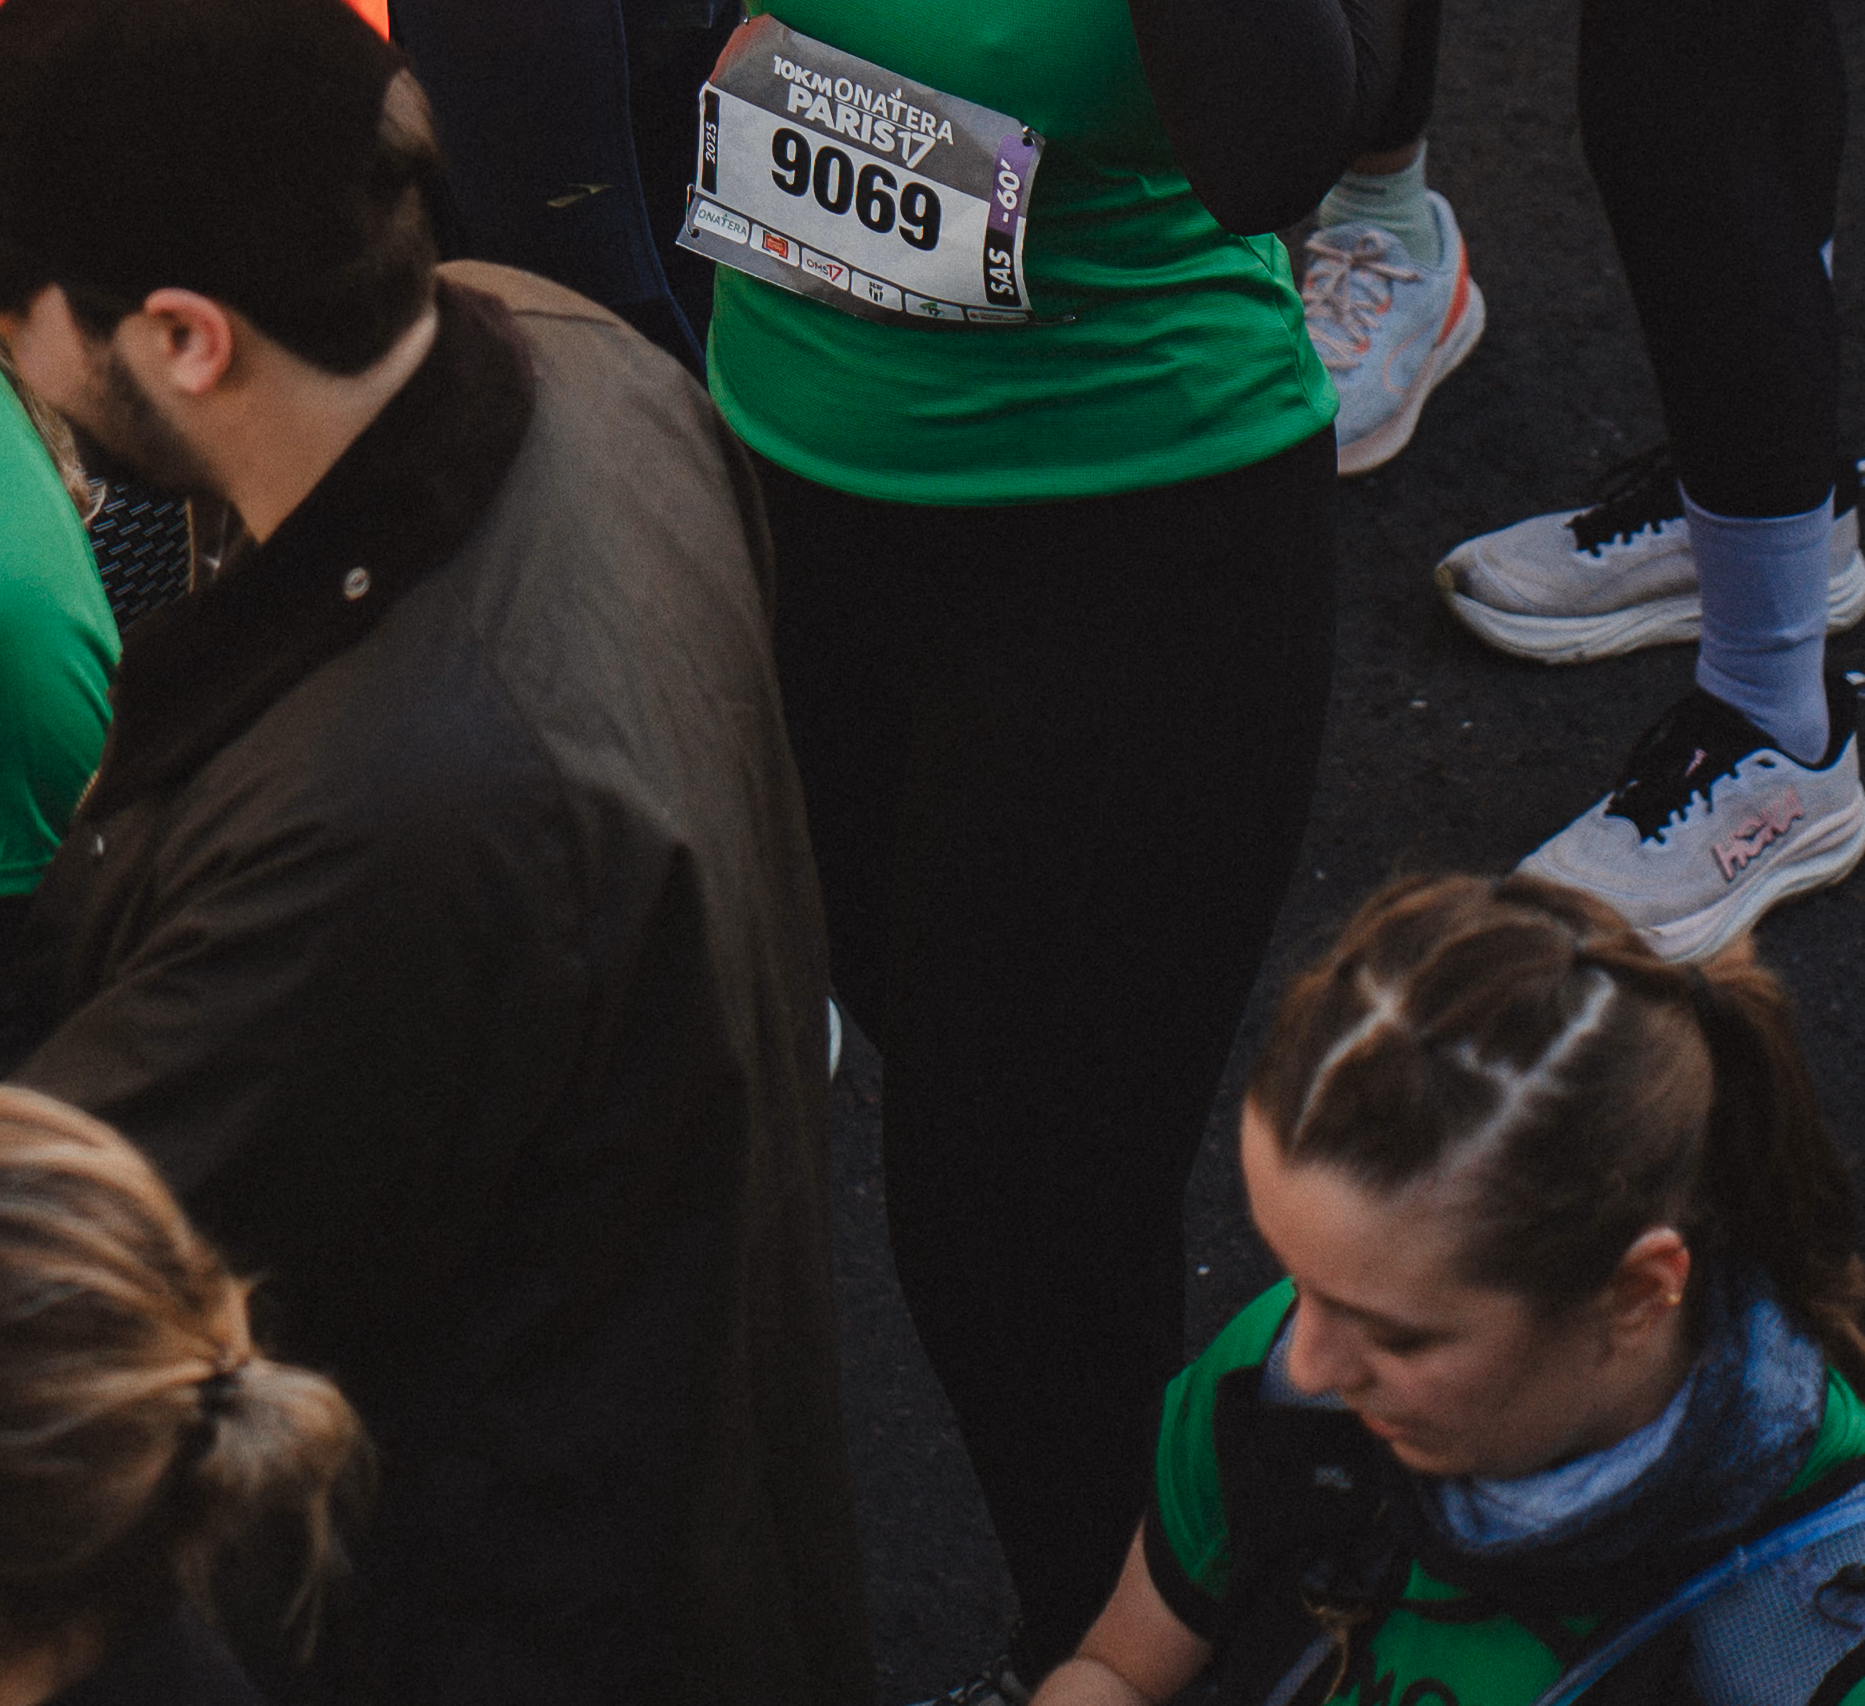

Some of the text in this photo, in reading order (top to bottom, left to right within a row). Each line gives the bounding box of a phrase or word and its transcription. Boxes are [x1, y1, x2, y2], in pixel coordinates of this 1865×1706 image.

[704, 121, 718, 165] 2025
[773, 54, 955, 147] 10KMONATERA
[786, 82, 937, 170] PARIS17
[697, 208, 748, 237] ONATERA
[770, 126, 943, 252] 9069
[988, 248, 1014, 297] SAS
[1713, 786, 1806, 874] HOKA
